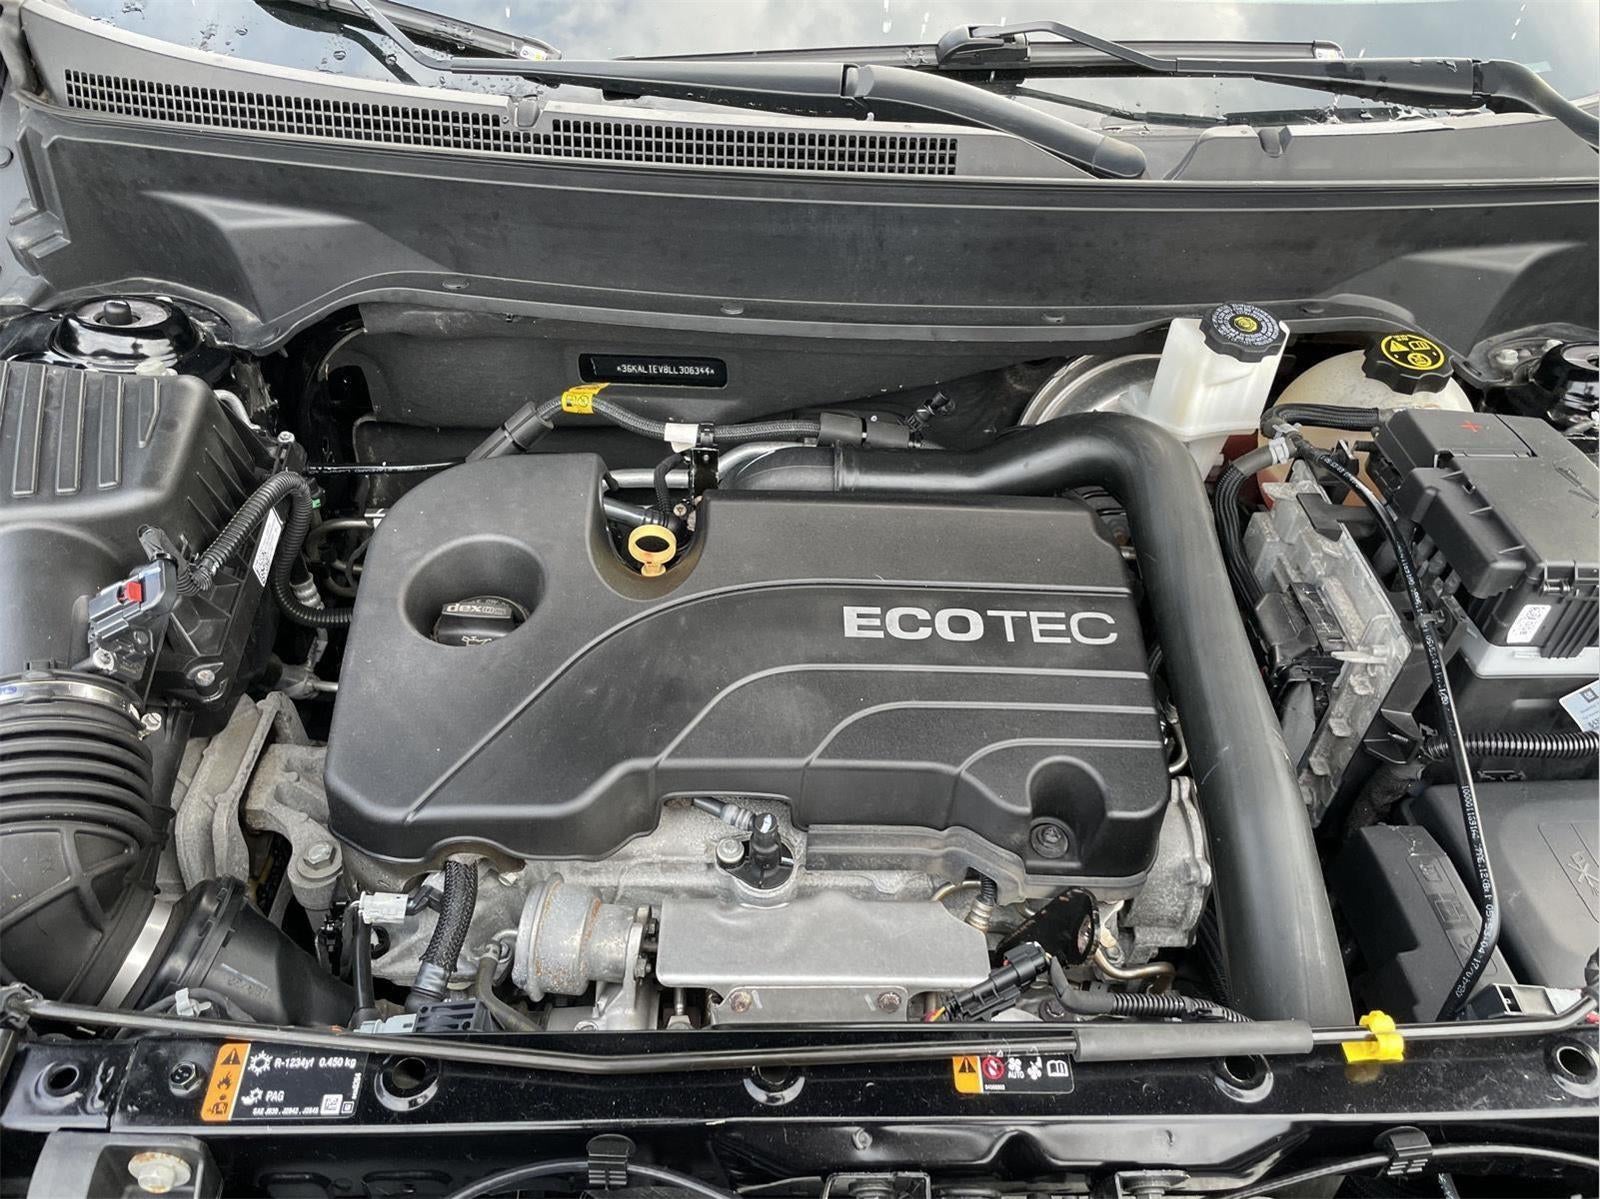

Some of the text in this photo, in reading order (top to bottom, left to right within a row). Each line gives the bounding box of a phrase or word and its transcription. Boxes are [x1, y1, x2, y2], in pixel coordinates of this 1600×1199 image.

[842, 605, 1118, 646] ECOTEC
[318, 1056, 344, 1069] 0.450
[344, 1057, 357, 1070] kg
[1007, 1070, 1025, 1079] AUTO
[265, 1090, 285, 1102] PAG
